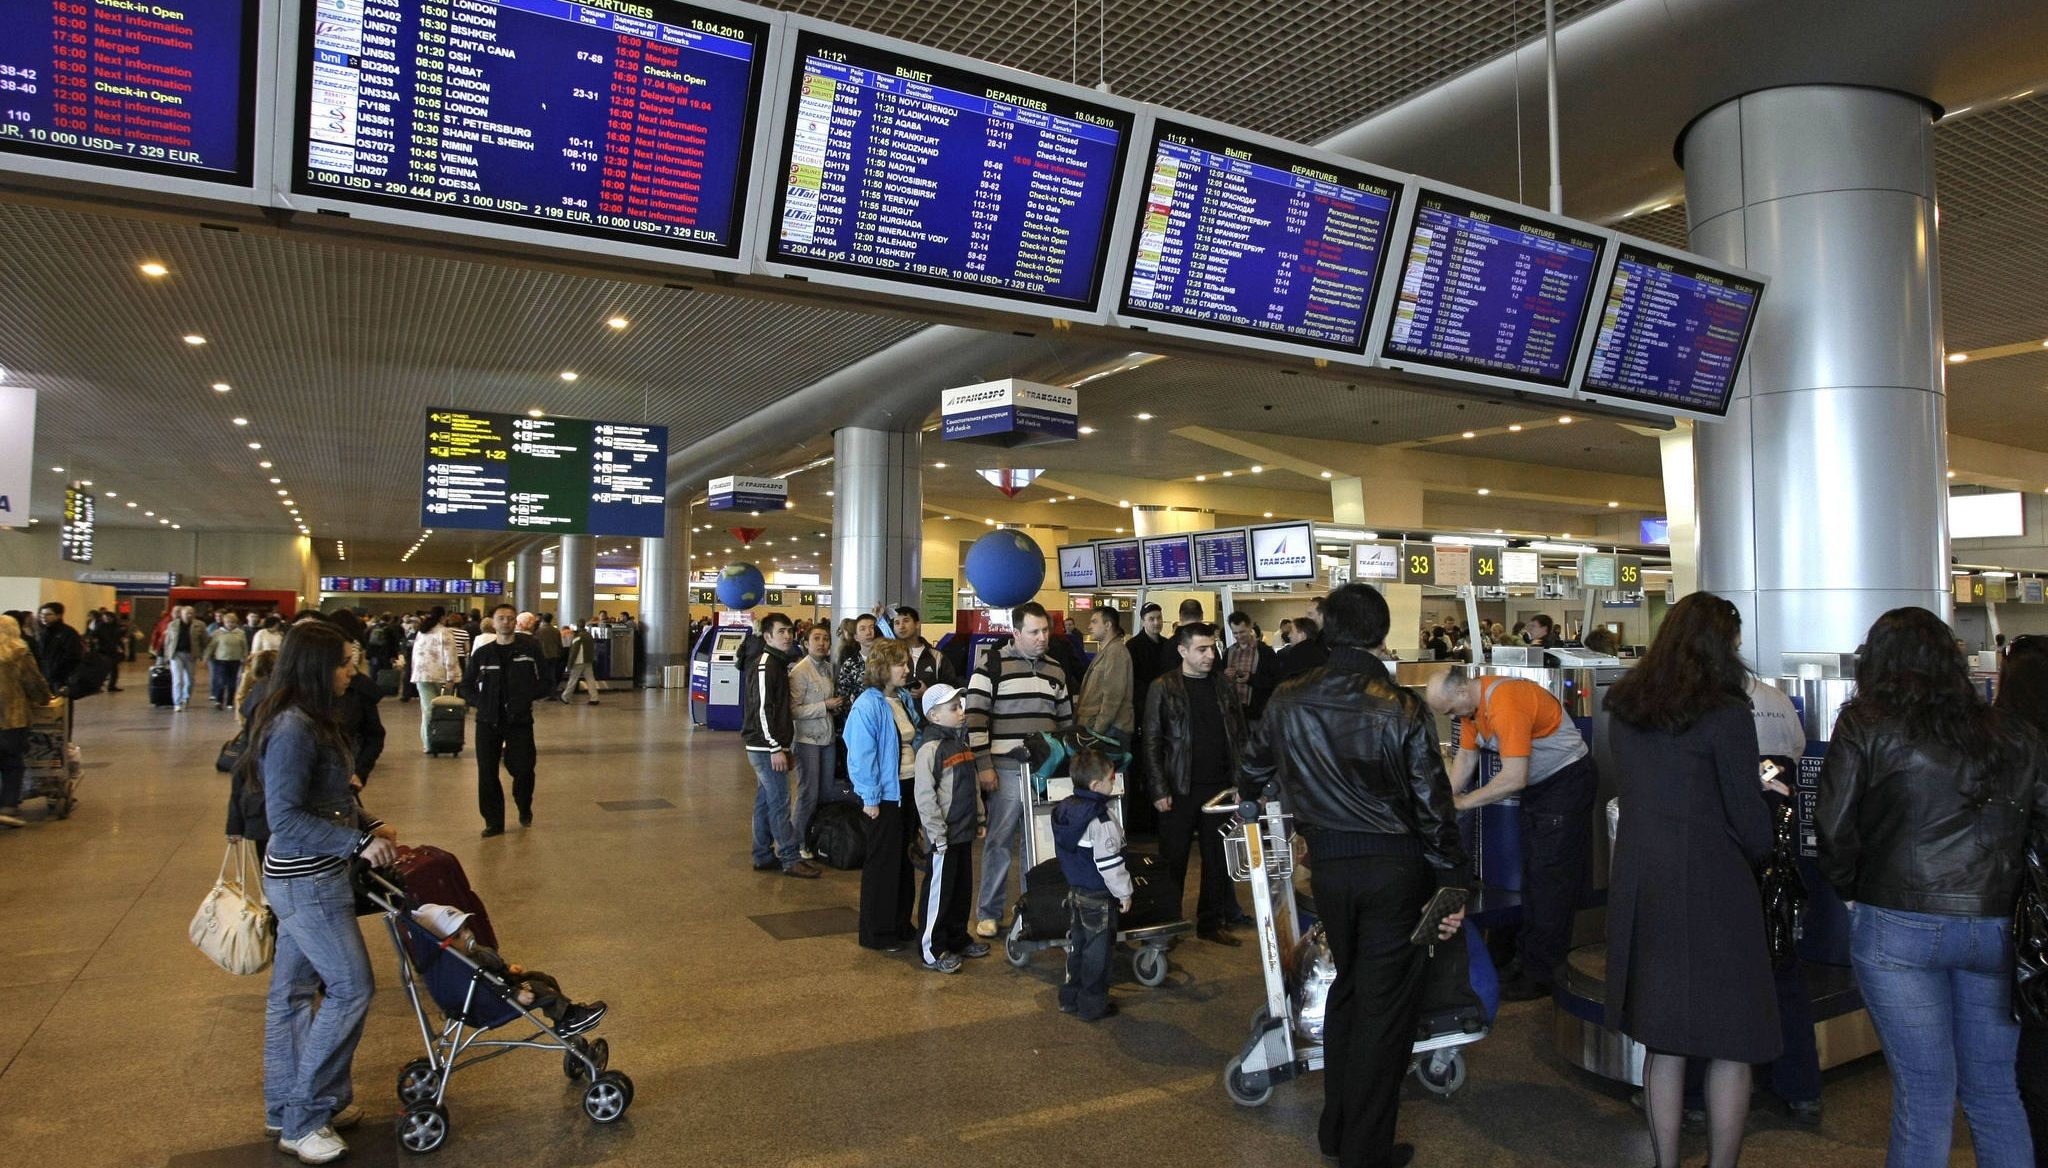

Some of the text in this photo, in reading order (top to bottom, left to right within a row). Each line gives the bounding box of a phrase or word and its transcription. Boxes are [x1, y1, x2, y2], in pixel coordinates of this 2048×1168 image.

[152, 6, 184, 20] Open
[452, 11, 677, 67] LONDON Merged
[580, 16, 689, 45] Desk Delayed until Remarks
[691, 19, 744, 40] 18.04.2010
[94, 38, 140, 54] Merged
[363, 17, 689, 94] UN573 16:50 PUNTA CANA flight
[416, 44, 471, 63] 01:20 OSH
[419, 17, 706, 86] 15:30 BISHKEK Check-in Open
[818, 49, 843, 62] 11:12
[321, 51, 490, 92] bmi 10:05 LONDON
[896, 66, 932, 83] ВЫЛЕТ
[0, 65, 182, 104] 38-42 12:05 Check-in Open
[447, 63, 674, 115] RABAT 23-31 Delayed
[0, 79, 191, 119] 38-40 12:00 Next information
[986, 89, 1047, 111] DEPARTURES
[7, 110, 30, 122] 110
[875, 103, 950, 126] 11:20 VLADIKAVKAZ
[876, 92, 1079, 145] 11:15 NOVY URENGOJ Gate Closed
[1075, 111, 1114, 128] 18.04.2010
[412, 109, 703, 168] 10:15 ST. PETERSBURG 10-11 Next information
[412, 121, 598, 161] 10:30 SHARM EL SHEIKH 108-110
[871, 124, 940, 146] 11:40 FRANKFURT
[895, 119, 1088, 168] AQABA Check-in Closed
[29, 128, 203, 164] 10 000 USD= 7 329 EUR.
[892, 140, 939, 156] KHUDZHAND
[1225, 147, 1252, 161] ВЫЛЕТ
[410, 147, 479, 166] 10:45 VIENNA
[442, 140, 587, 172] RIMINI 110
[890, 151, 1001, 180] KOGALYM 12-14
[888, 161, 1075, 206] NADYM Open
[1291, 165, 1337, 183] DEPARTURES
[408, 172, 587, 208] 11:00 ODESSA 38-40
[886, 172, 938, 189] NOVOSIBIRSK
[975, 190, 1001, 201] 112-119
[1046, 204, 1061, 214] Gate
[1222, 192, 1257, 205] КРАСНОДАР
[884, 193, 919, 207] YEREVAN
[385, 182, 718, 242] 290 444 руб 3 000 10 000 USD= 7 329 EUR.
[882, 204, 914, 216] SURGUT
[858, 211, 1066, 255] 12:00 HURGHADA Check-in Open
[876, 236, 917, 249] SALEHARD
[878, 225, 948, 244] MINERALNYE VODY
[875, 246, 916, 259] TASHKENT
[791, 244, 1025, 289] 290 444 329
[956, 389, 1005, 404] ТРАНСАЭРО
[1026, 391, 1072, 405] TRANSAERO
[954, 424, 971, 432] check-in
[485, 450, 506, 460] 1-22
[1259, 556, 1306, 566] TRANSAERO
[1411, 556, 1429, 574] 33
[1478, 558, 1494, 575] 34
[1622, 566, 1637, 582] 35
[702, 592, 712, 600] 12
[1974, 584, 1983, 596] 40
